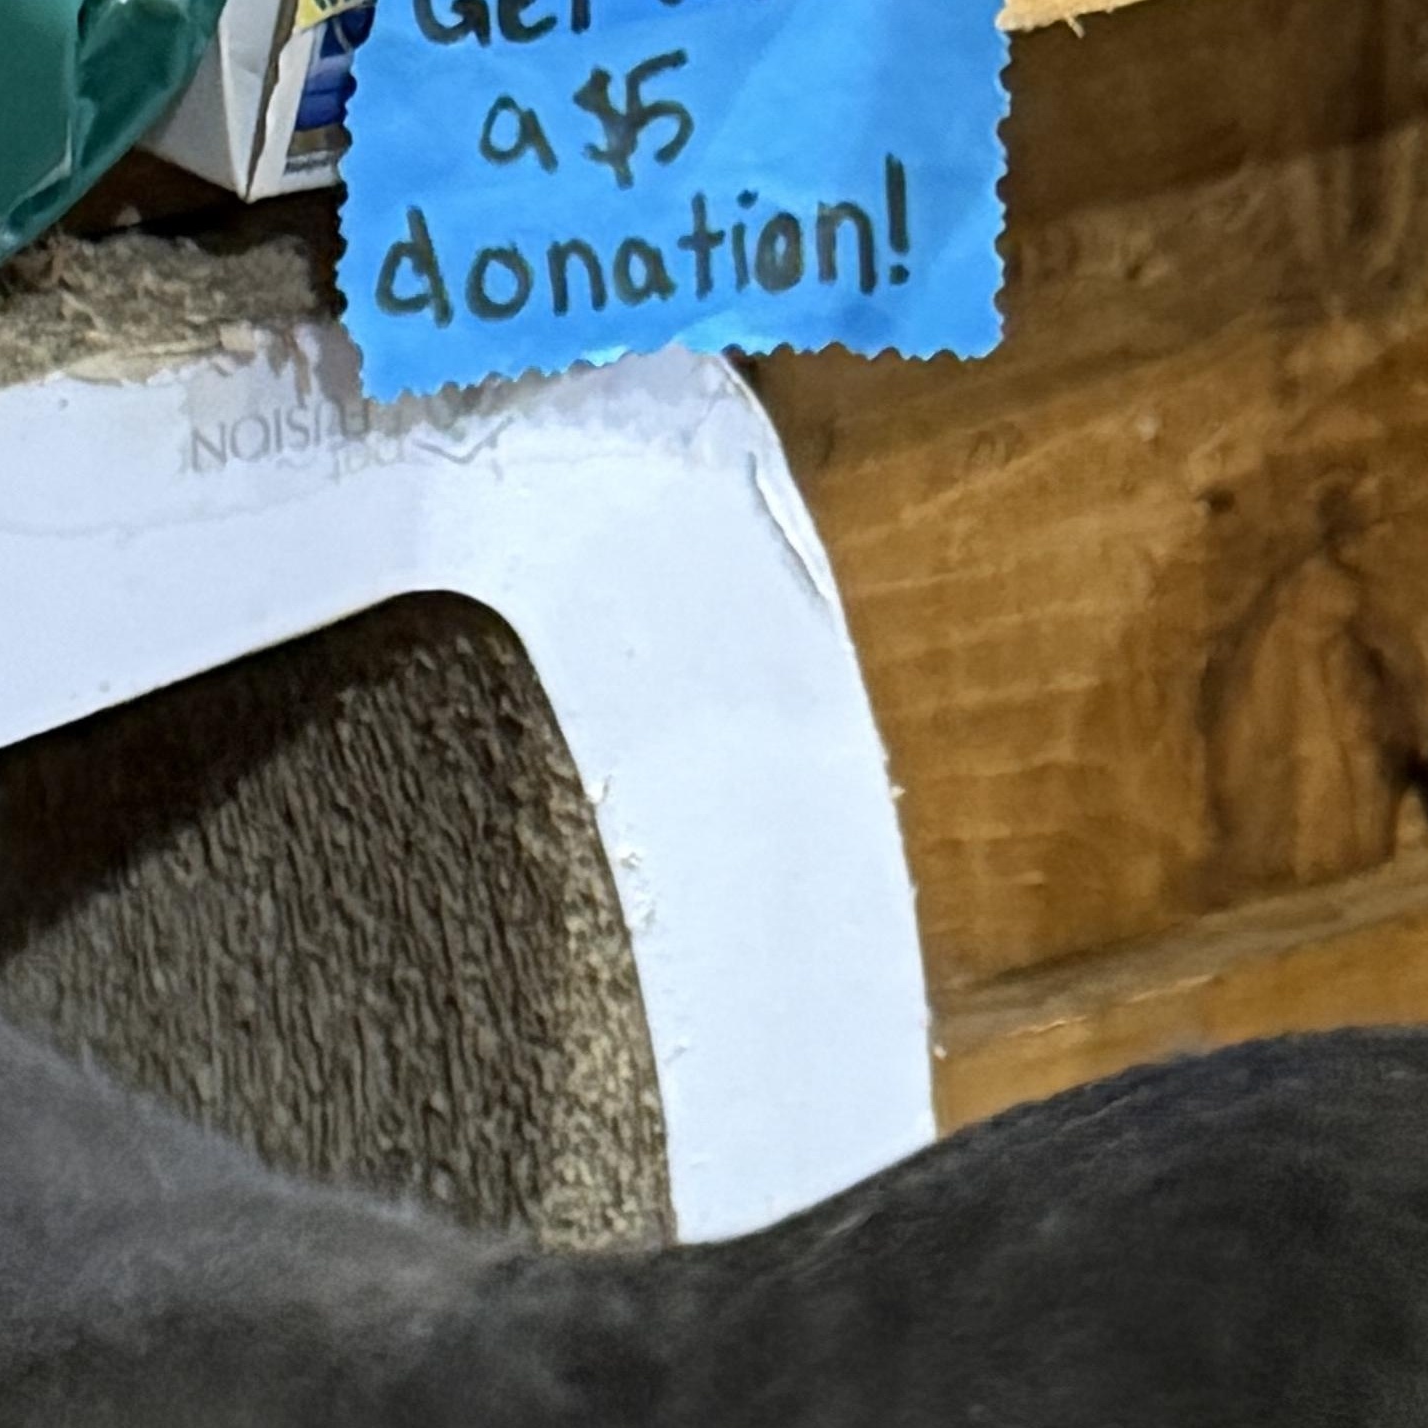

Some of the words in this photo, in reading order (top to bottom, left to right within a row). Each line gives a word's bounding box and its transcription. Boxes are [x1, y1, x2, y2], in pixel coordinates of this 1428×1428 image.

[478, 92, 560, 175] a
[573, 48, 695, 190] $5
[375, 153, 910, 328] donation!
